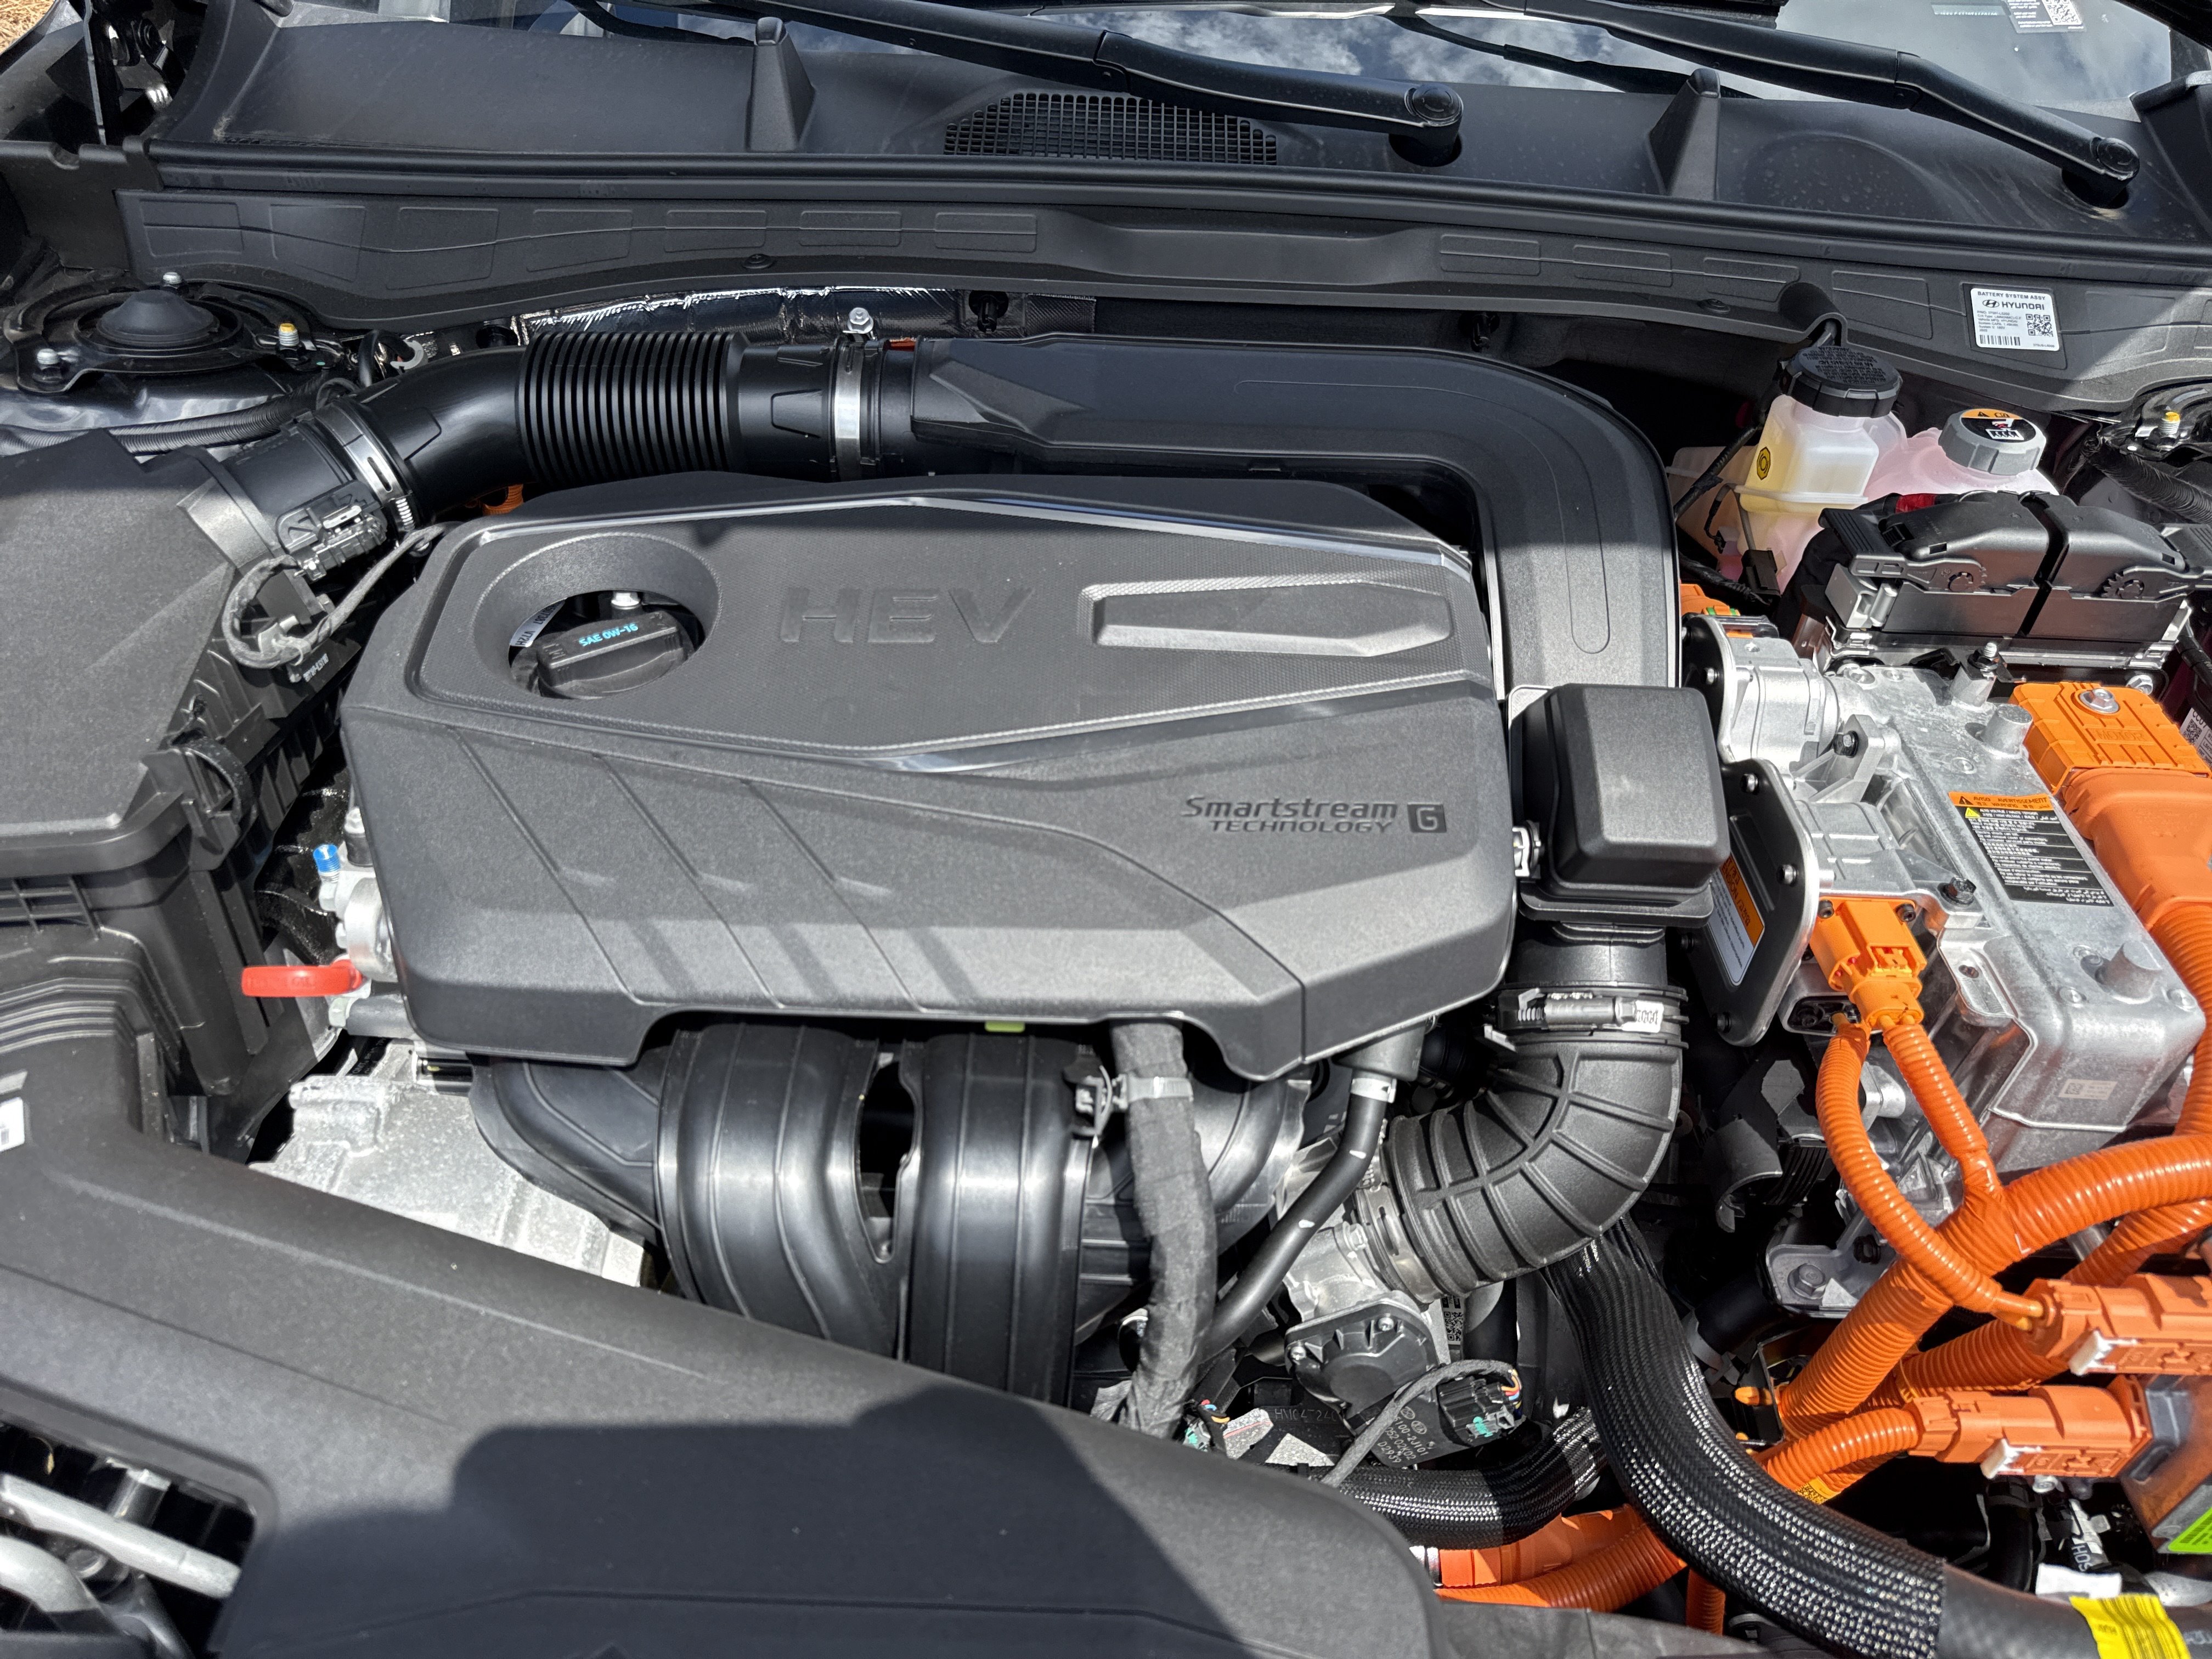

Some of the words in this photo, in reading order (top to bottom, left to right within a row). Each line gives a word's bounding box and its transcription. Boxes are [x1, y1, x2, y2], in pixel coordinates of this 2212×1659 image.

[2002, 301, 2045, 310] HYUNDAI
[779, 586, 1034, 644] HEV
[515, 630, 536, 646] V72H
[579, 634, 603, 647] SAE
[602, 623, 639, 639] 0W-16
[1181, 794, 1397, 820] Smartstream
[1412, 804, 1443, 832] G
[1210, 820, 1393, 833] TECHNOLOGY
[1393, 1416, 1429, 1456] 5100-2J101
